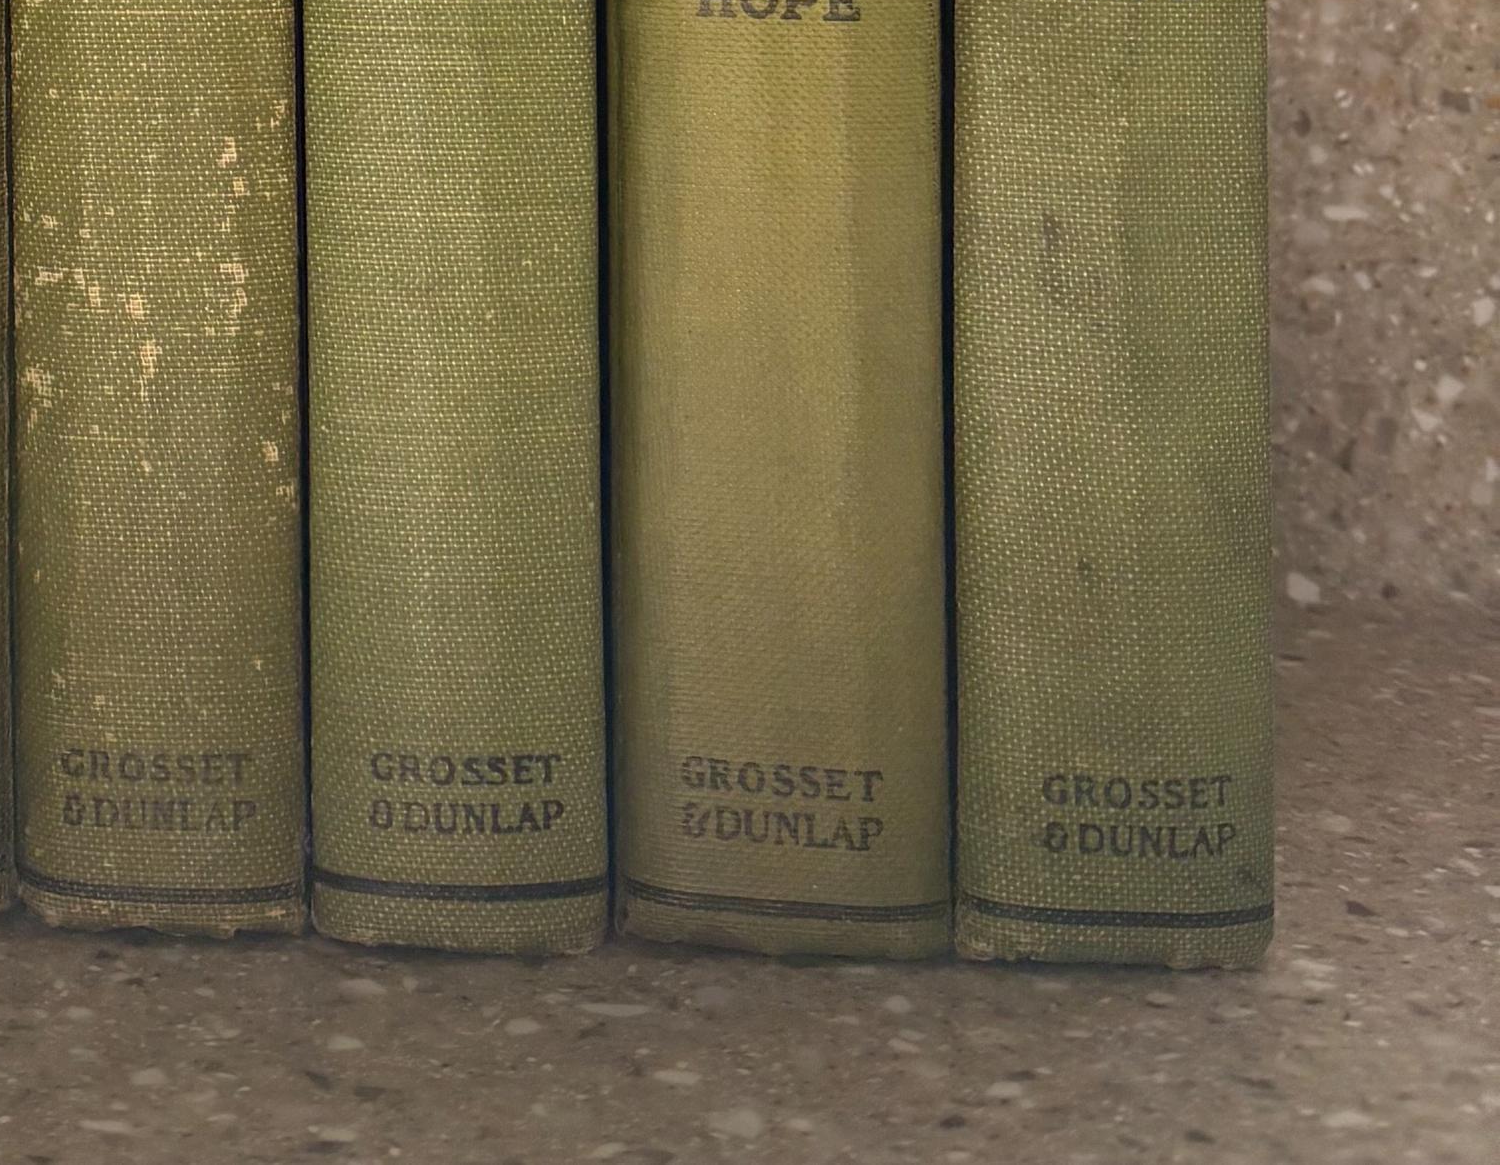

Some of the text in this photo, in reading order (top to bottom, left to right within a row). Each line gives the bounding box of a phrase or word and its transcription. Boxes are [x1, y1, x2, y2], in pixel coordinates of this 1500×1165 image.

[60, 749, 253, 786] GROSSET
[371, 752, 561, 787] GROSSET
[682, 756, 883, 802] GROSSET
[1042, 774, 1233, 810] GROSSET
